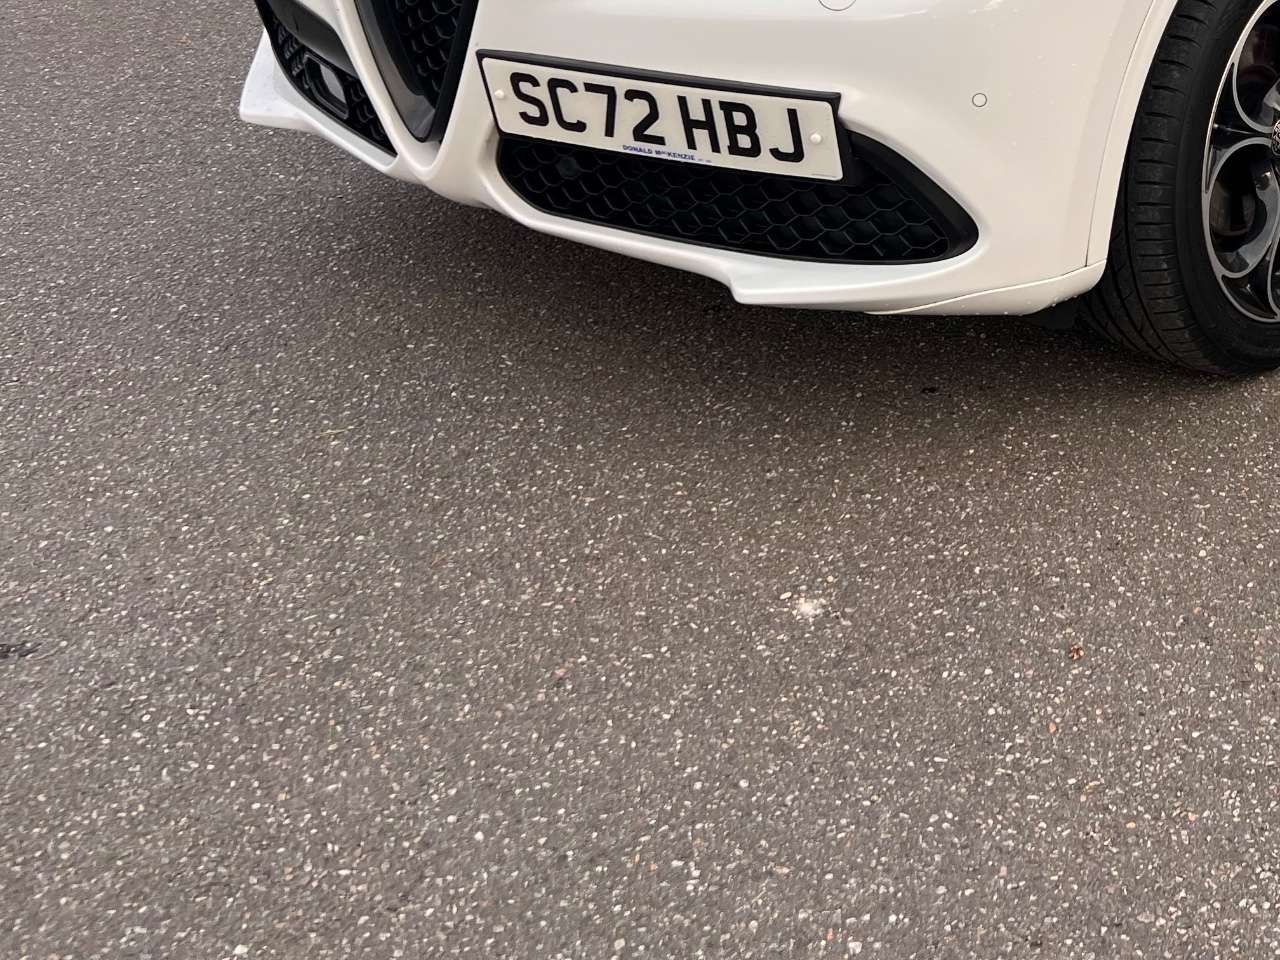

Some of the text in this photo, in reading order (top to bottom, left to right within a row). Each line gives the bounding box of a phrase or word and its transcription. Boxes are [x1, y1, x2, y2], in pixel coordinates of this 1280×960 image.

[509, 72, 805, 163] SC72 HBJ
[622, 144, 653, 155] DONALD
